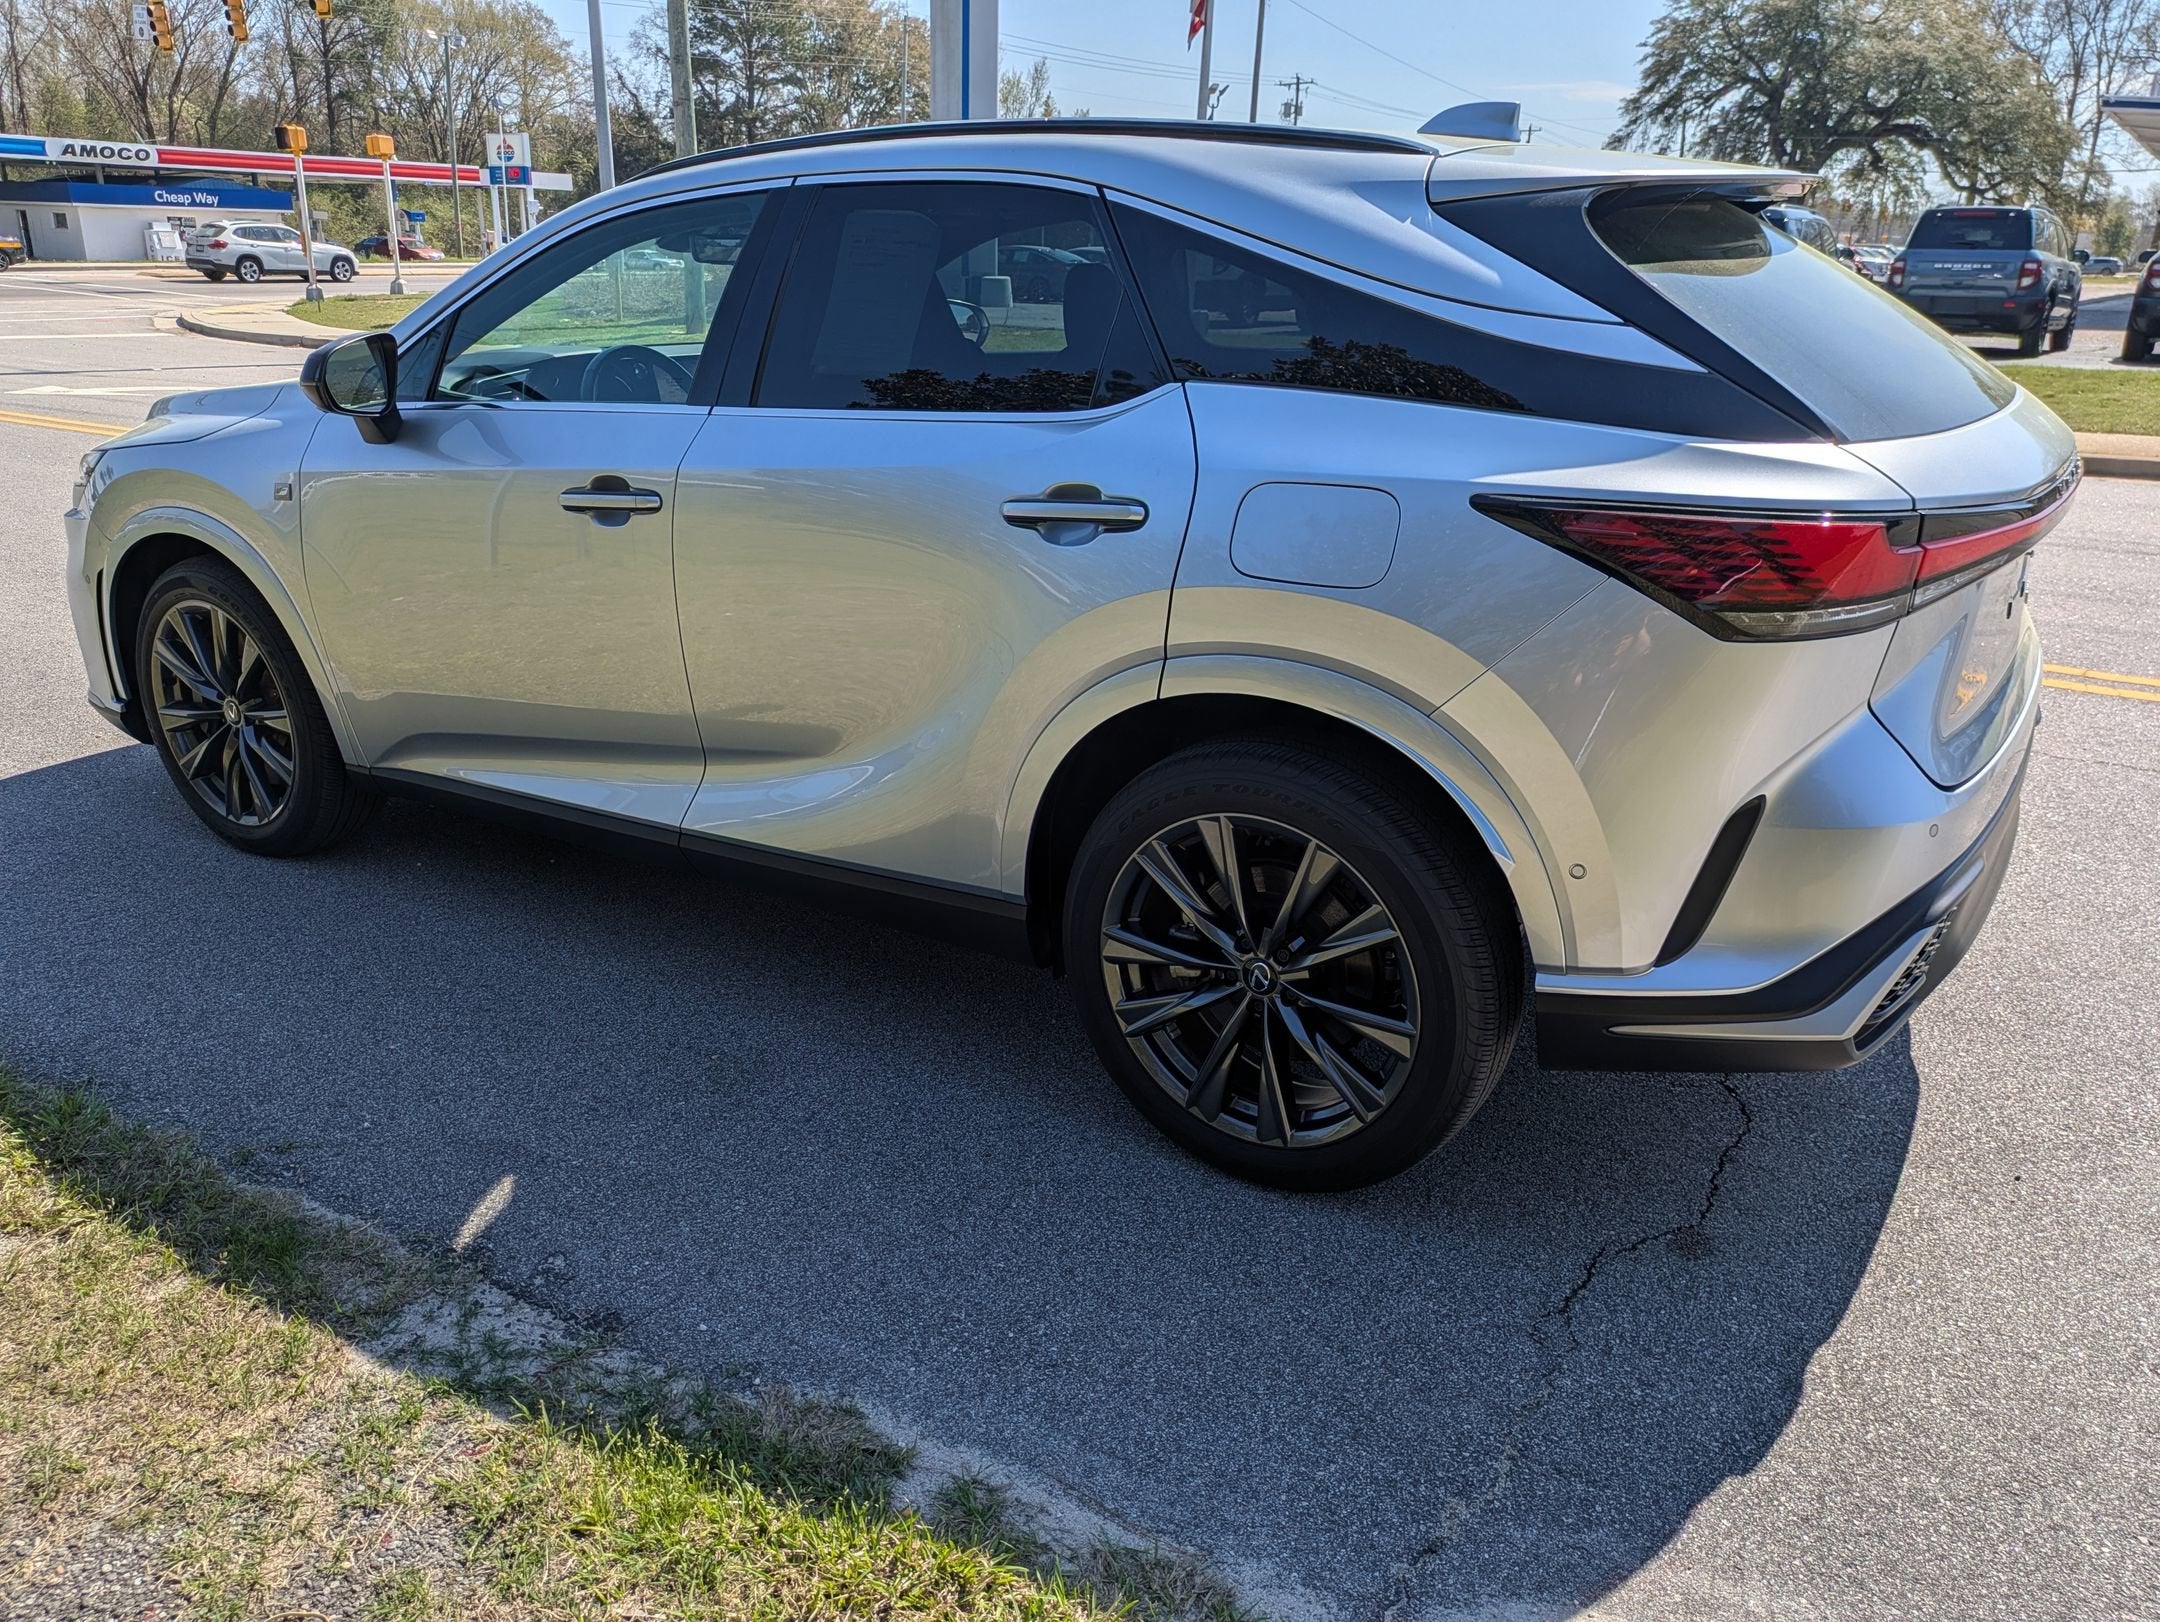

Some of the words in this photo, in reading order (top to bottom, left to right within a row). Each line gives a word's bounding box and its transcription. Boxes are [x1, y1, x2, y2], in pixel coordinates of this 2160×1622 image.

[61, 143, 151, 162] AMOCO
[154, 190, 192, 206] Cheap
[194, 192, 219, 207] Way
